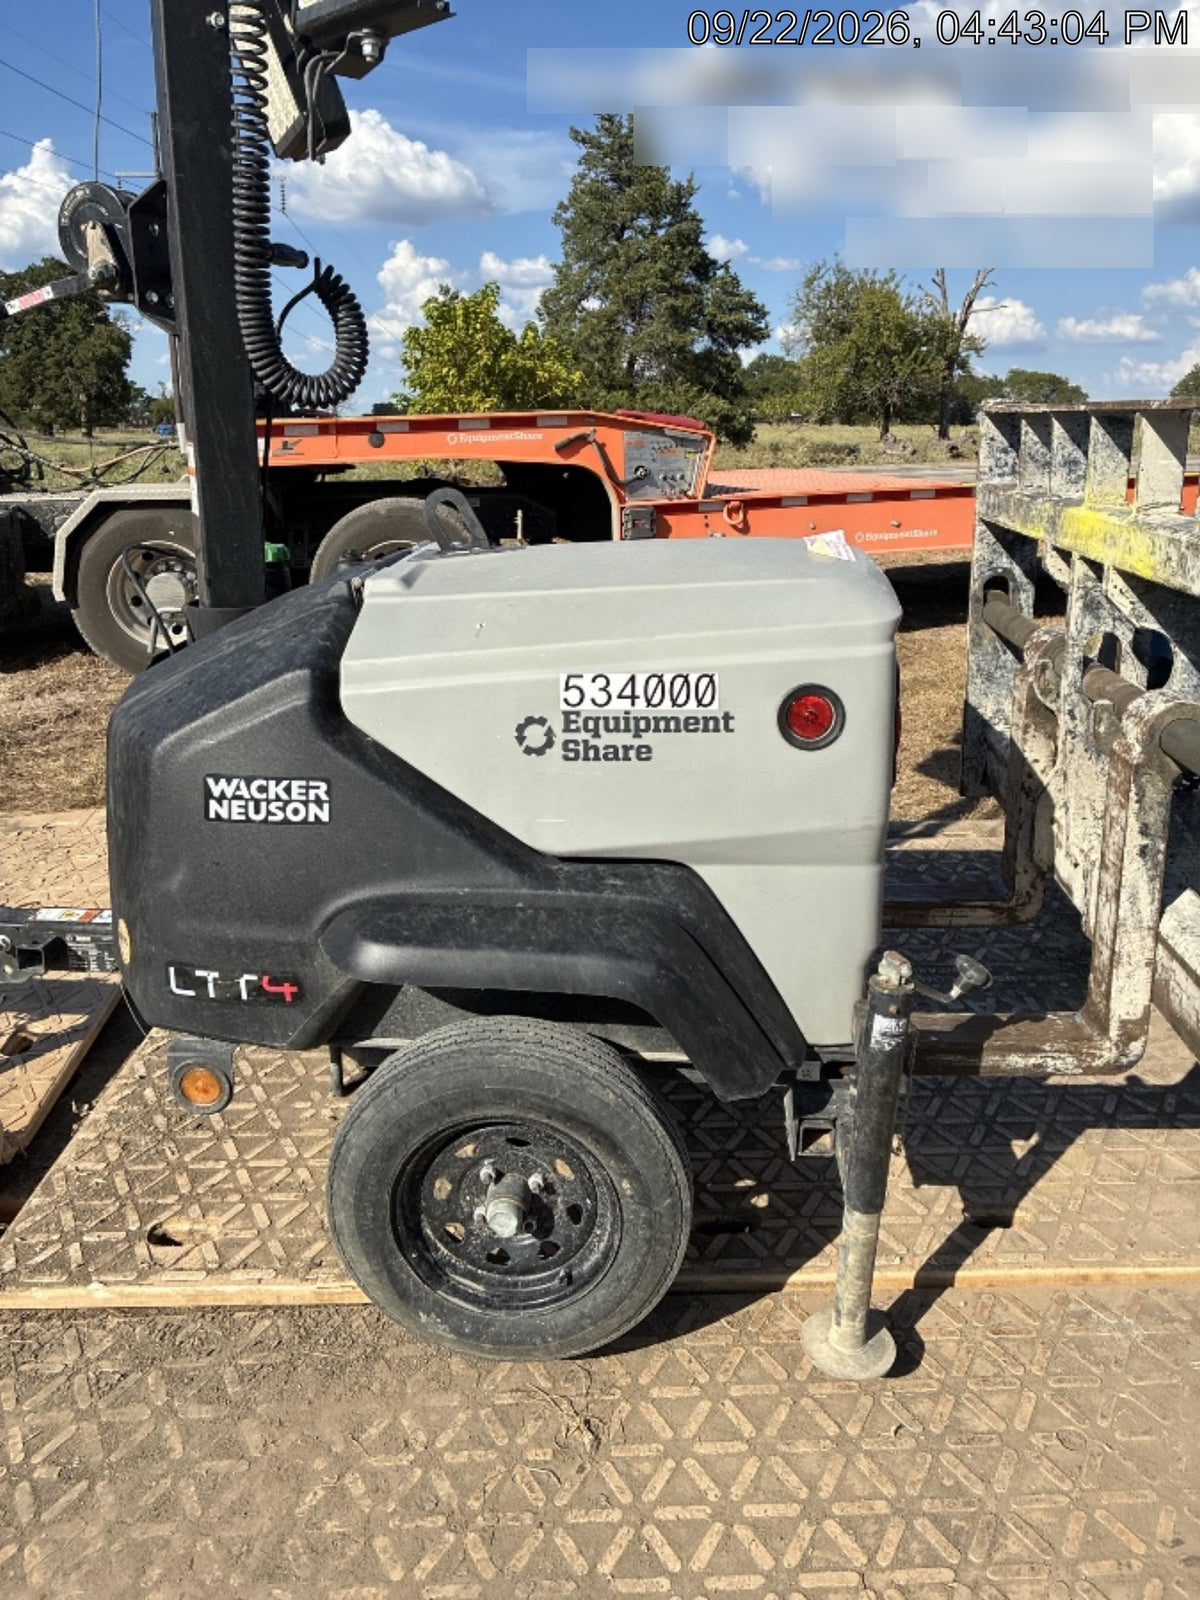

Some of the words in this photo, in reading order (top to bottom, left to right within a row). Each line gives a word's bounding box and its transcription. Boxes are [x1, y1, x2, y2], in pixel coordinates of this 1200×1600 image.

[459, 431, 543, 443] EquipmentShare
[562, 673, 716, 708] 534000
[561, 711, 735, 738] Equipment
[561, 739, 653, 761] Share
[206, 777, 330, 801] WACKER
[209, 799, 330, 822] NEUSON
